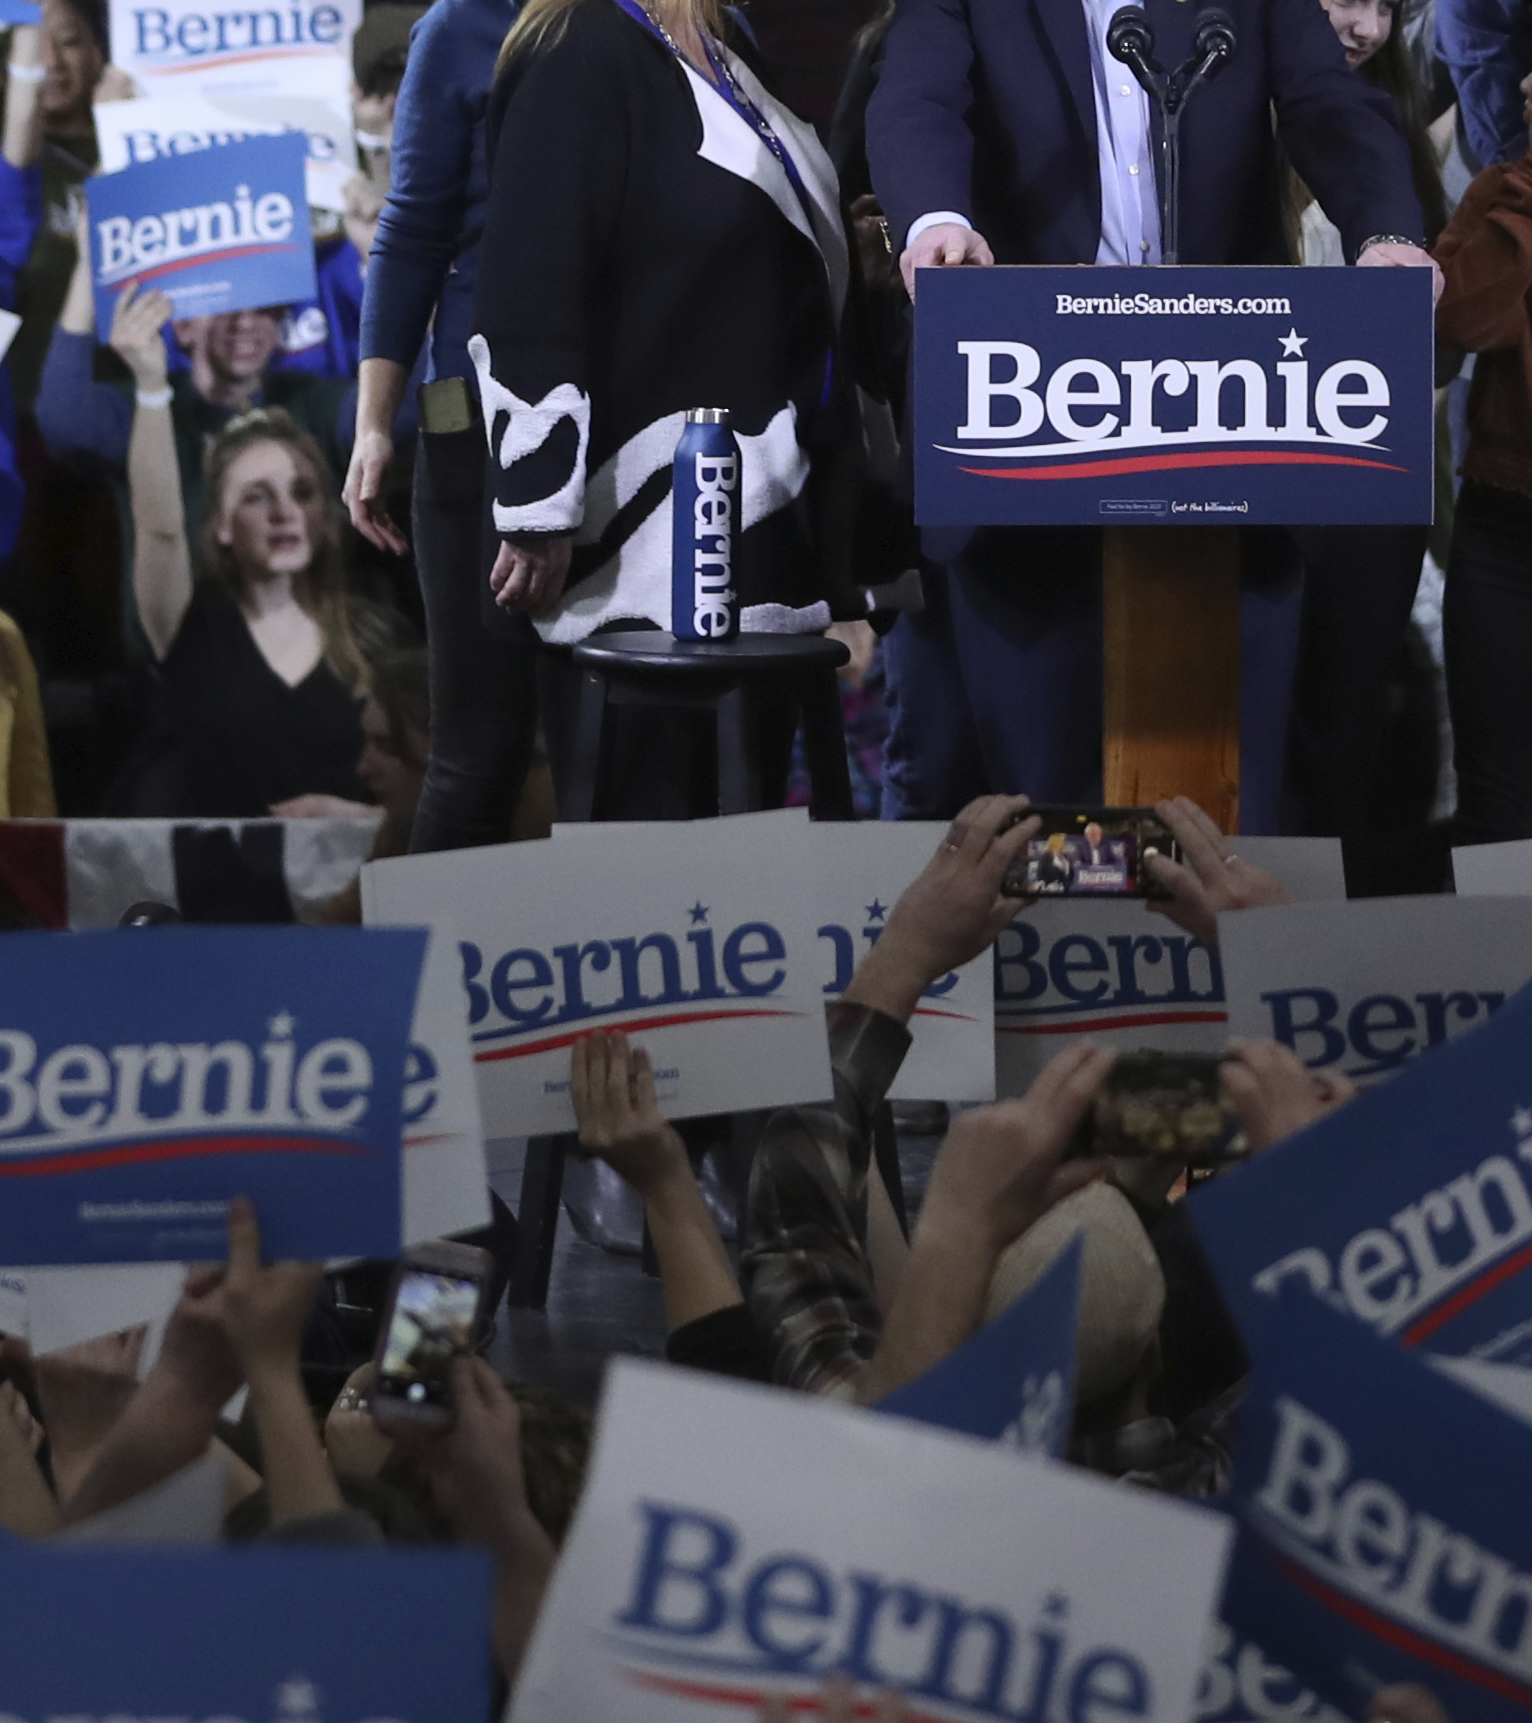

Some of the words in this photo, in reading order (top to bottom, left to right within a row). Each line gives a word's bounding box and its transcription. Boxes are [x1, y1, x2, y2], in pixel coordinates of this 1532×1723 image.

[97, 185, 294, 277] Bernie
[1055, 293, 1291, 317] BernieSanders.com
[956, 327, 1392, 442] Bernie
[693, 451, 738, 637] Bernie
